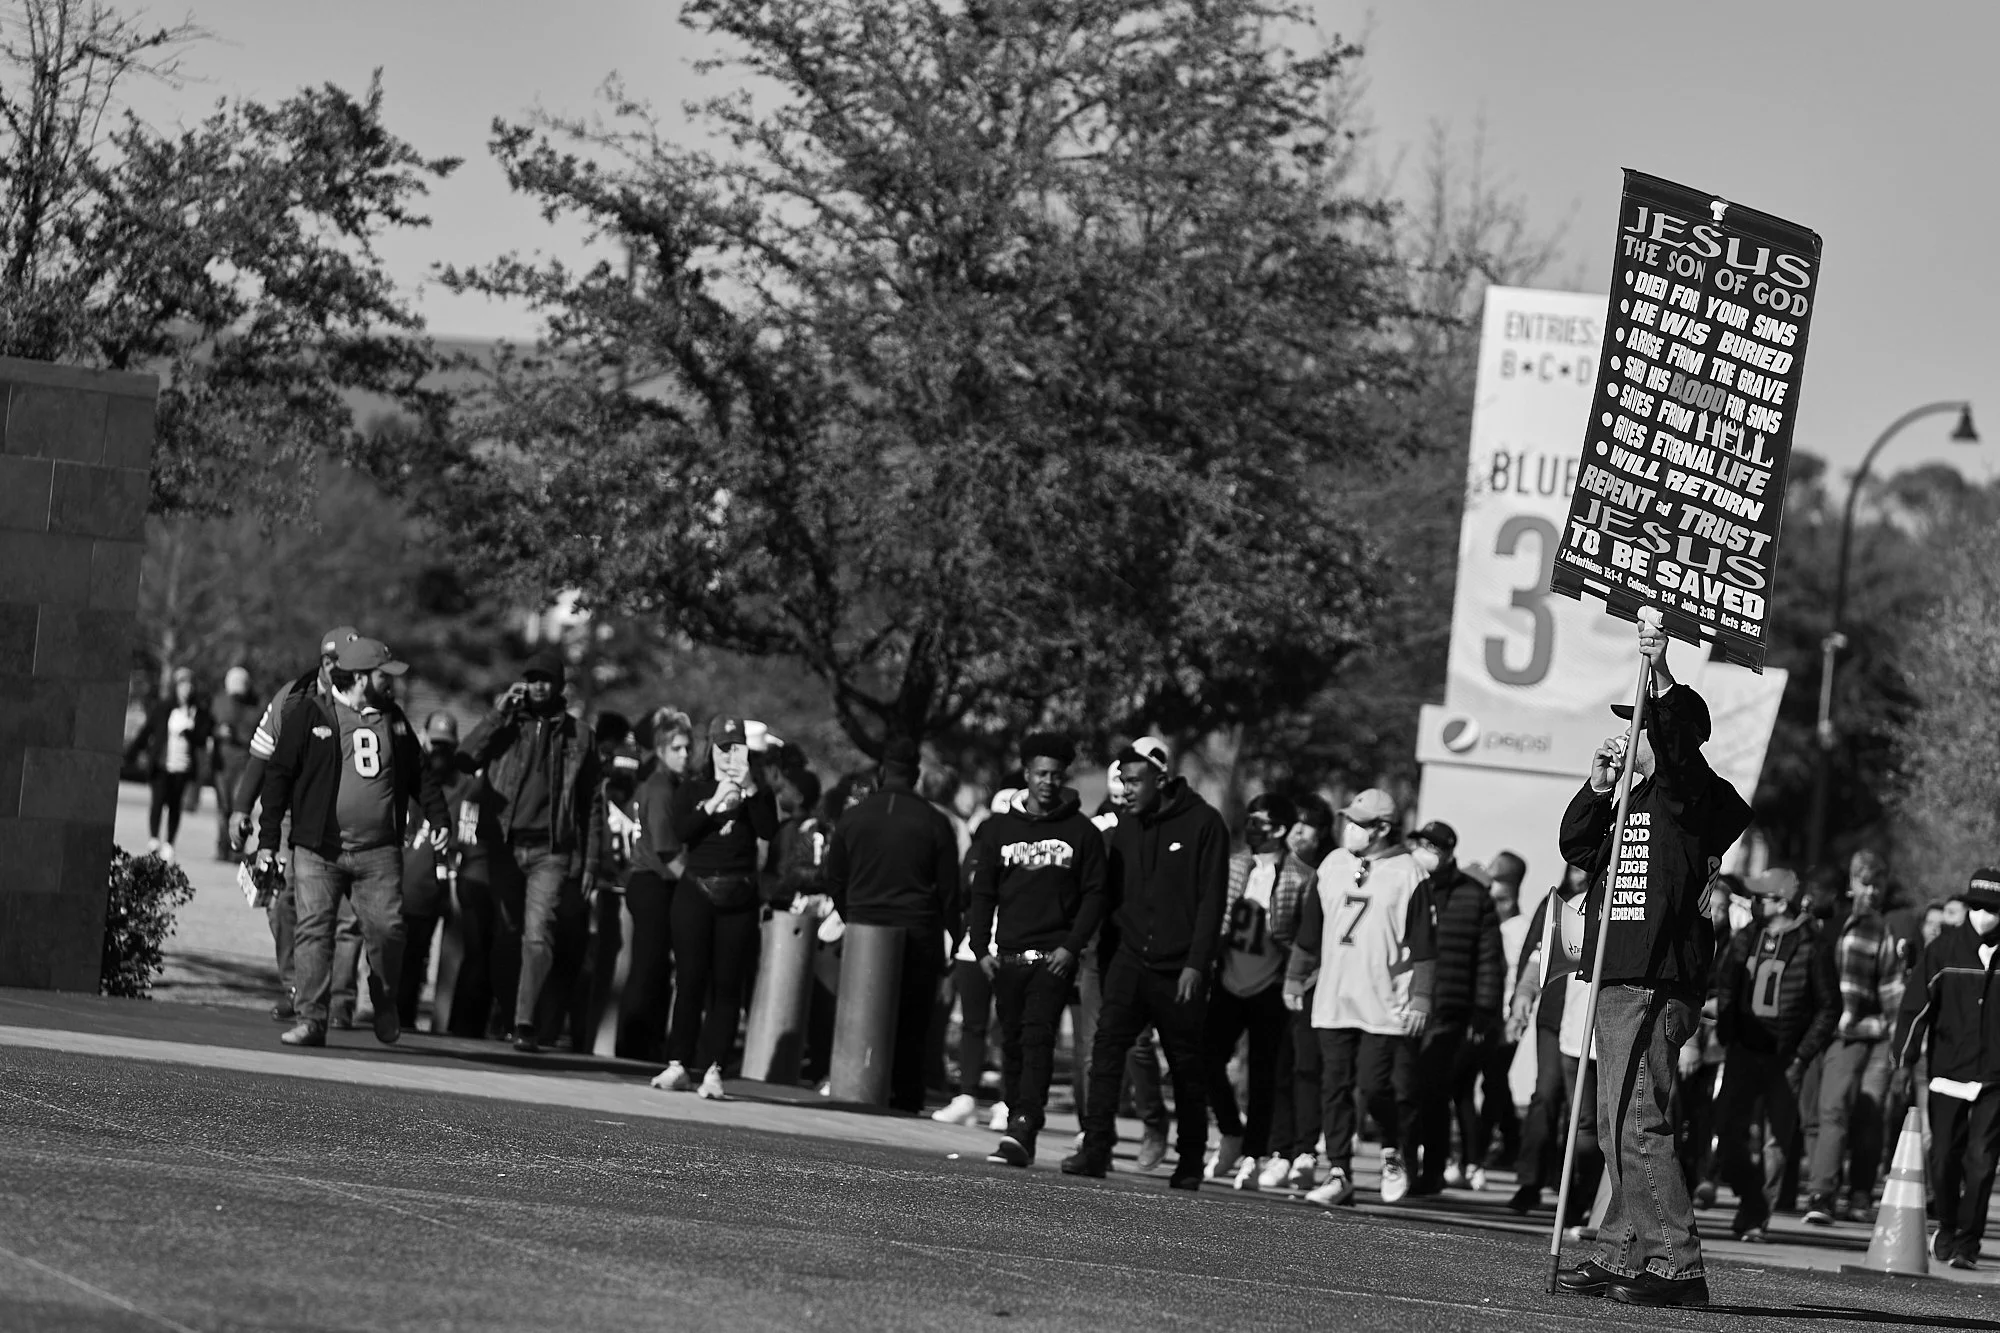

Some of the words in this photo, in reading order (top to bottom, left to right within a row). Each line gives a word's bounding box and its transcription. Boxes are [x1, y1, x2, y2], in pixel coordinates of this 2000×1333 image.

[1622, 234, 1662, 267] THE
[1666, 250, 1707, 283] SON
[1714, 268, 1748, 295] OF
[1752, 281, 1809, 317] GOD
[1623, 206, 1812, 289] JESUS
[1630, 299, 1660, 326] HE
[1659, 310, 1712, 346] WAS
[1716, 331, 1794, 375] BURIED
[1633, 270, 1668, 300] DIED
[1668, 283, 1701, 313] FOR
[1705, 296, 1750, 330] YOUR
[1752, 314, 1799, 347] SINS
[1646, 366, 1671, 393] HIS
[1667, 372, 1727, 413] BLOOD
[1723, 393, 1746, 422] FOR
[1745, 403, 1783, 434] SINS
[1666, 342, 1705, 375] FRM
[1710, 358, 1736, 386] THE
[1736, 367, 1789, 407] GRAVE
[1650, 430, 1716, 475] ETRNAL
[1716, 455, 1772, 496] LIFE
[1656, 400, 1695, 434] FRM
[1694, 409, 1774, 469] HELL
[1491, 452, 1578, 497] BLUE
[1579, 463, 1657, 514] REPENT
[1678, 503, 1772, 558] TRUST
[1609, 445, 1661, 482] WILL
[1664, 468, 1765, 522] RETURN
[1570, 521, 1601, 556] TO
[1611, 539, 1651, 577] BE
[1656, 560, 1766, 621] SAVED
[1573, 498, 1767, 590] JESUS
[1484, 514, 1560, 686] 3
[1560, 548, 1567, 560] 1
[1565, 550, 1603, 575] Corinthians
[1661, 590, 1676, 606] 1:14
[1681, 598, 1698, 615] John
[1699, 604, 1716, 621] 3:16
[1720, 612, 1739, 630] Acts
[1740, 620, 1762, 638] 20:21
[352, 728, 380, 778] 8
[1341, 894, 1372, 947] 7
